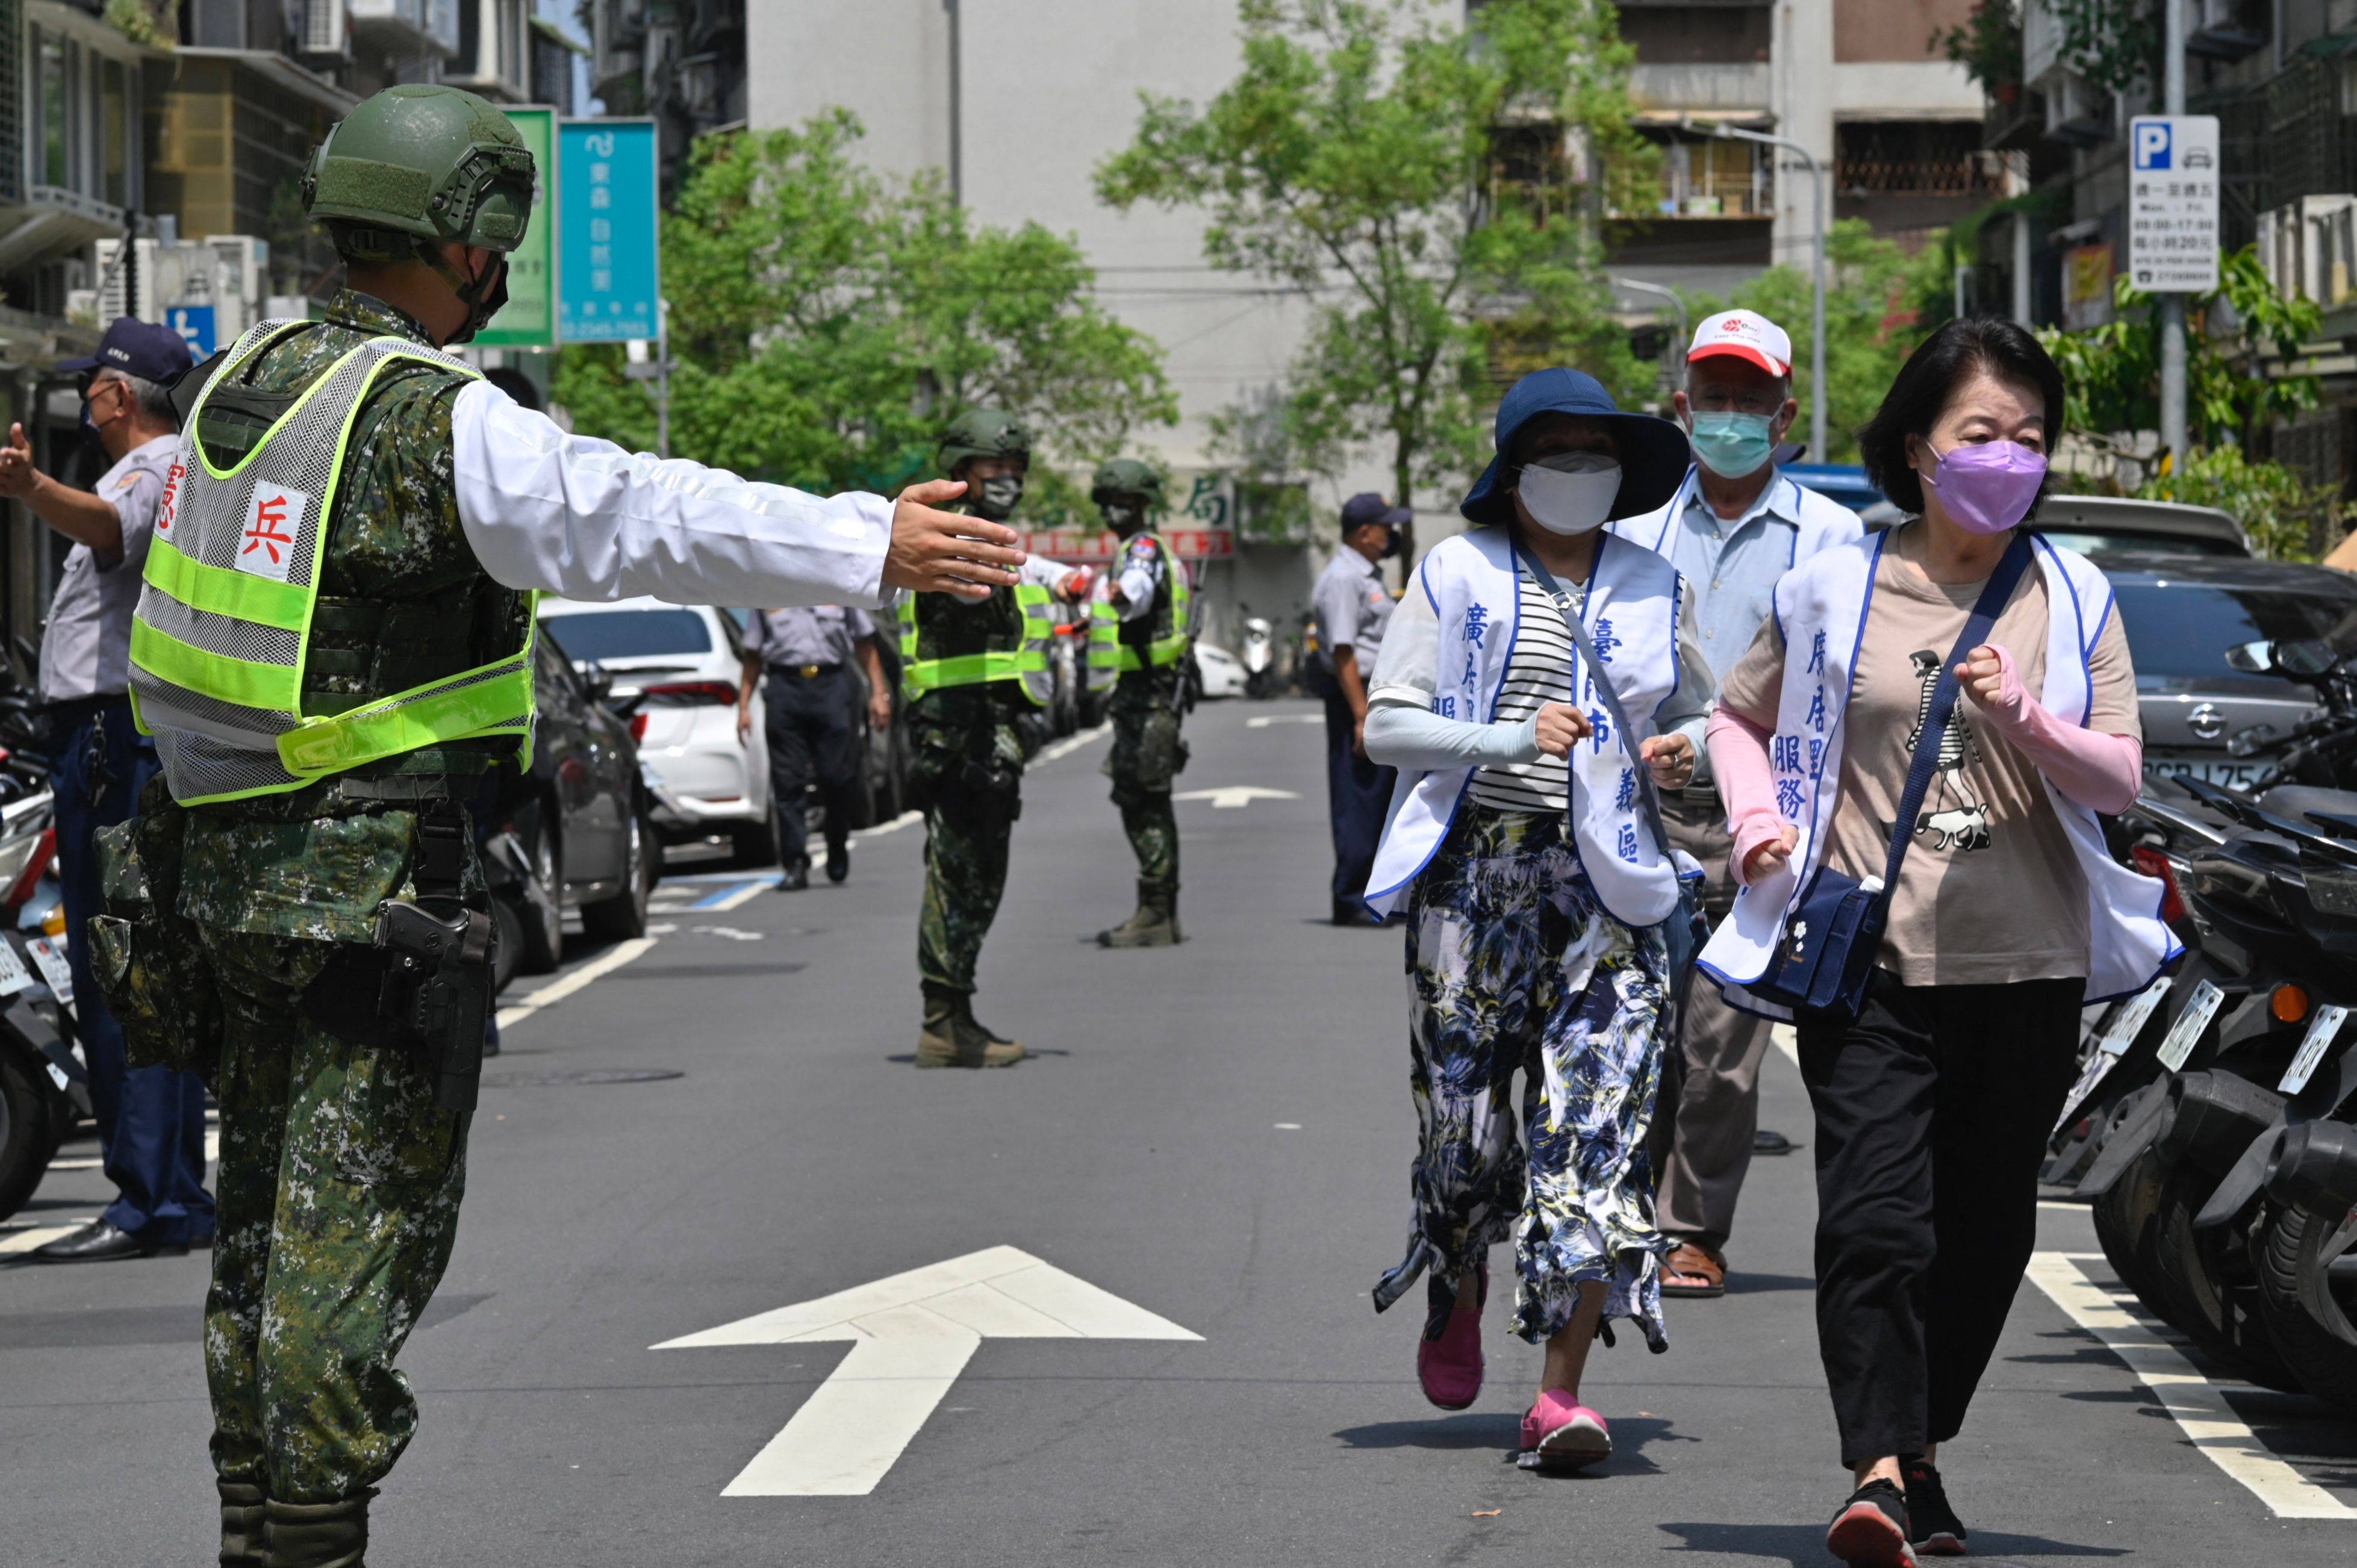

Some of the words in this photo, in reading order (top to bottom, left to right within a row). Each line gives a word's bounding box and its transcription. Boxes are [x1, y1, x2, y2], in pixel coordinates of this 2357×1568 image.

[2138, 126, 2168, 167] P
[242, 495, 292, 564] 兵
[1805, 629, 1827, 781] 廣居里
